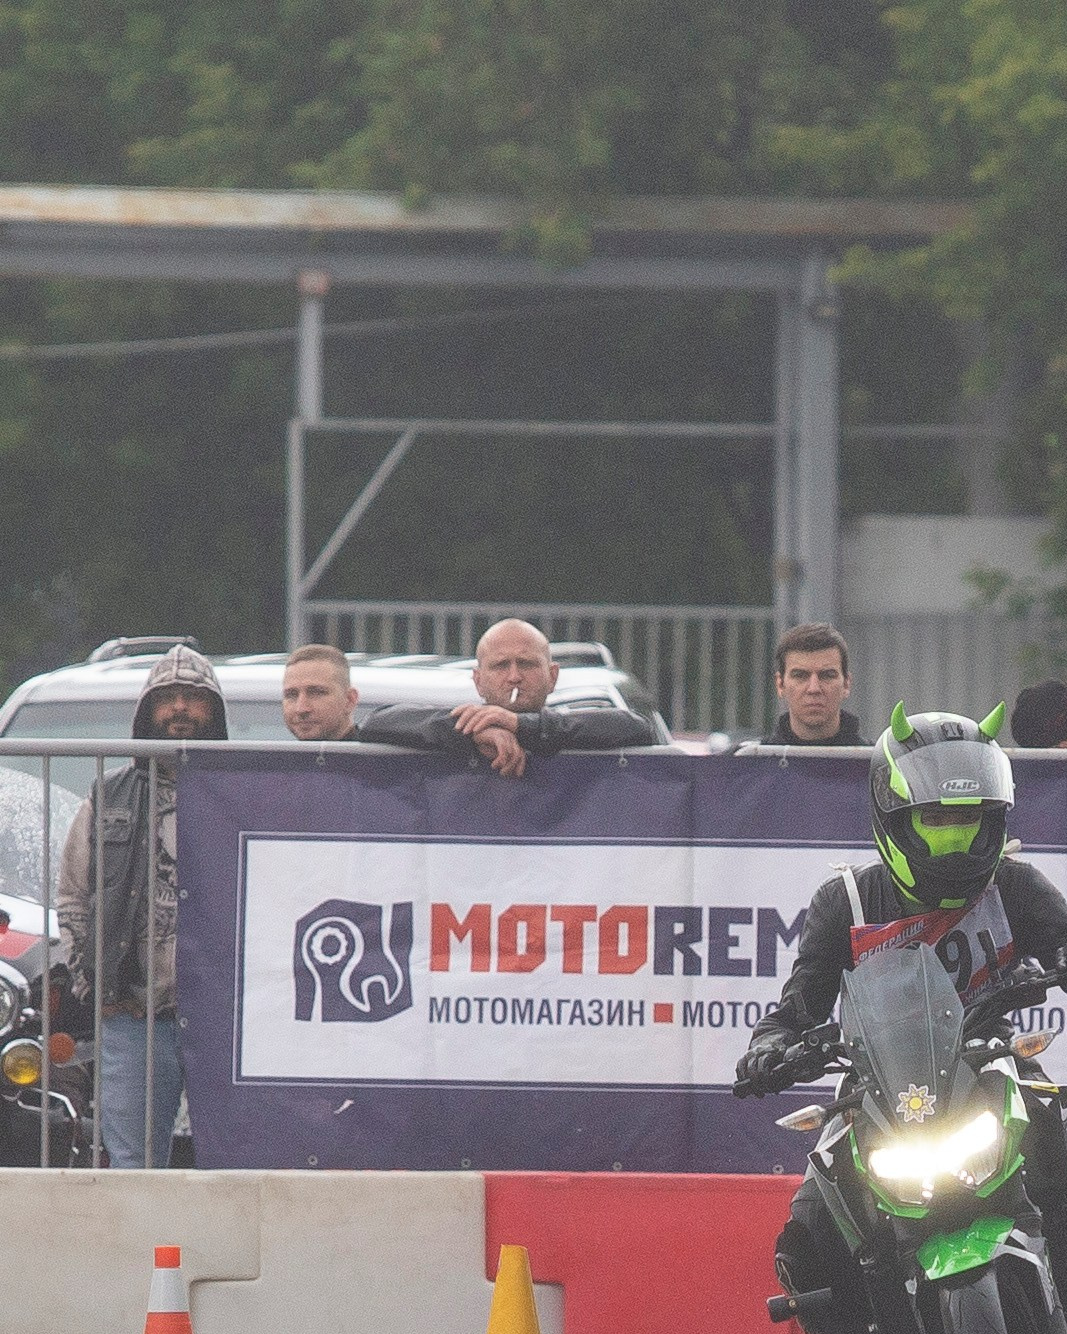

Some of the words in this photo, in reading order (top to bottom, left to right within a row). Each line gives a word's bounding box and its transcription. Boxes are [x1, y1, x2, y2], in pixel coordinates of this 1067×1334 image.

[944, 780, 978, 791] HJC
[430, 903, 811, 977] MOTOREM
[904, 928, 1003, 990] 91
[428, 997, 645, 1027] МОТОМАГАЗИН
